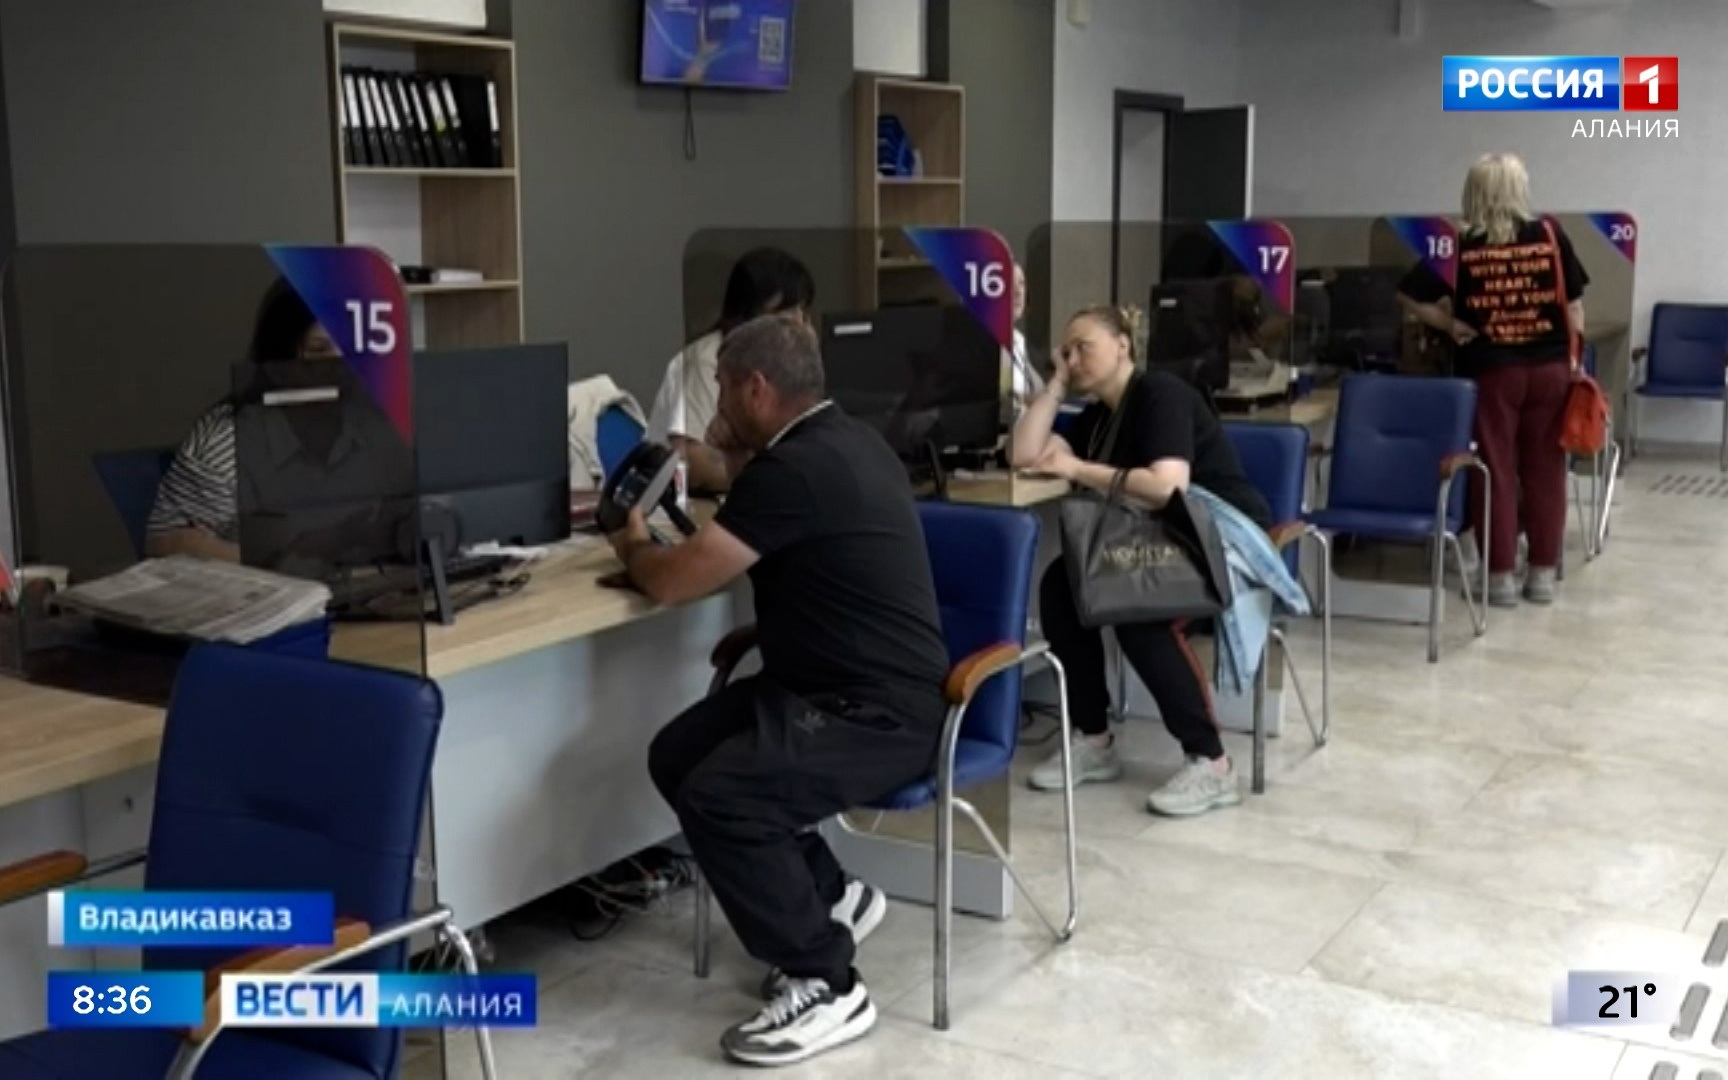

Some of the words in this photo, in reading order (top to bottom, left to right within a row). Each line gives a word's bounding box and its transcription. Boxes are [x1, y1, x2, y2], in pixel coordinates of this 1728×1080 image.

[1610, 224, 1635, 241] 20
[1258, 246, 1289, 273] 17
[1426, 235, 1454, 258] 18
[964, 261, 1006, 298] 16
[345, 301, 396, 354] 15
